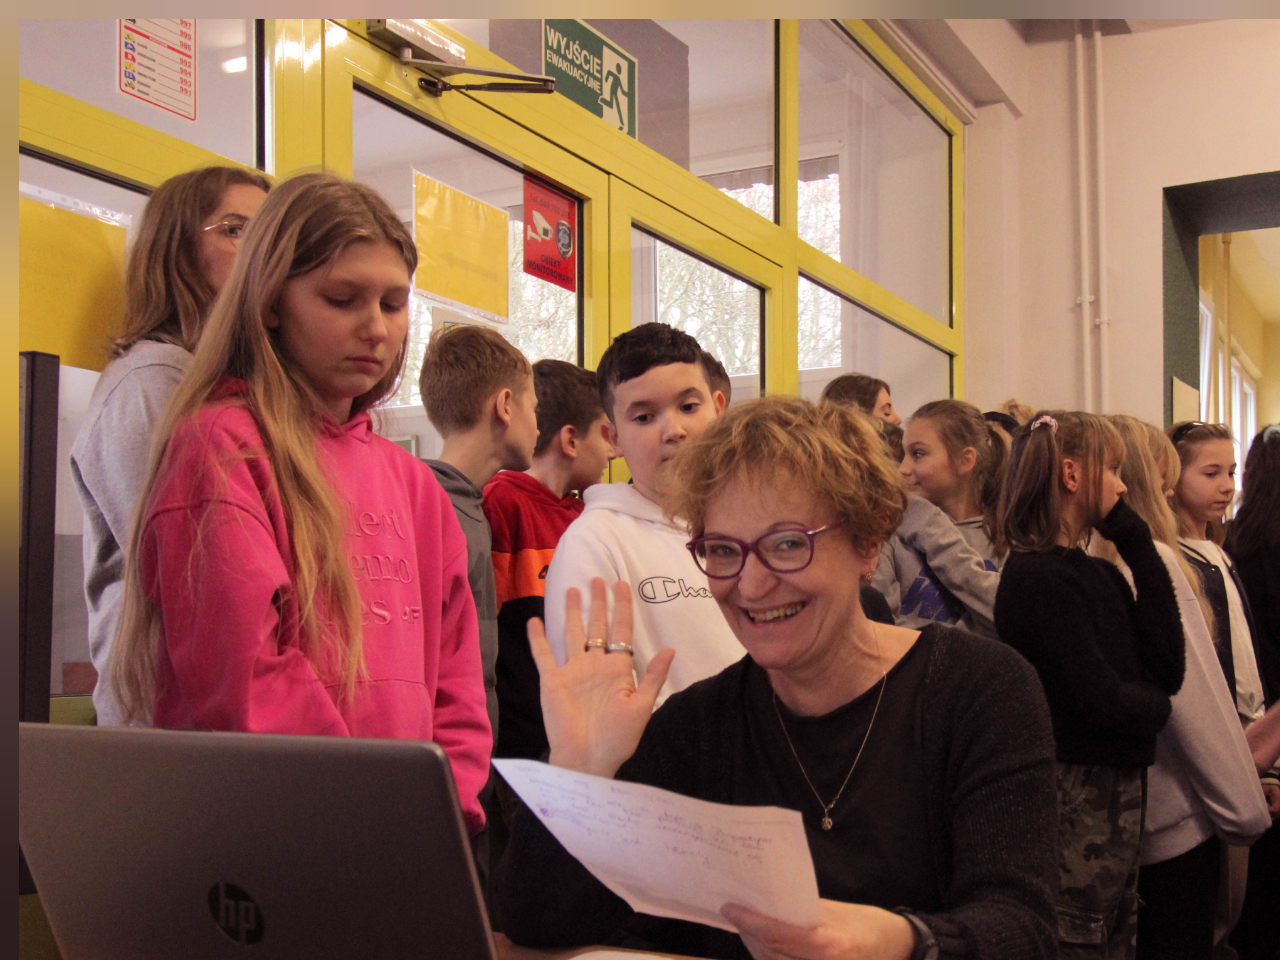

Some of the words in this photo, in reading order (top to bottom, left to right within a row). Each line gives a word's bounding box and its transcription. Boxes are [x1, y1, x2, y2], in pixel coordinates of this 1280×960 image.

[546, 25, 601, 79] WYJŚCIE
[546, 49, 602, 94] EWAKUACYJNE
[638, 576, 713, 604] Cha
[219, 881, 256, 945] hp
